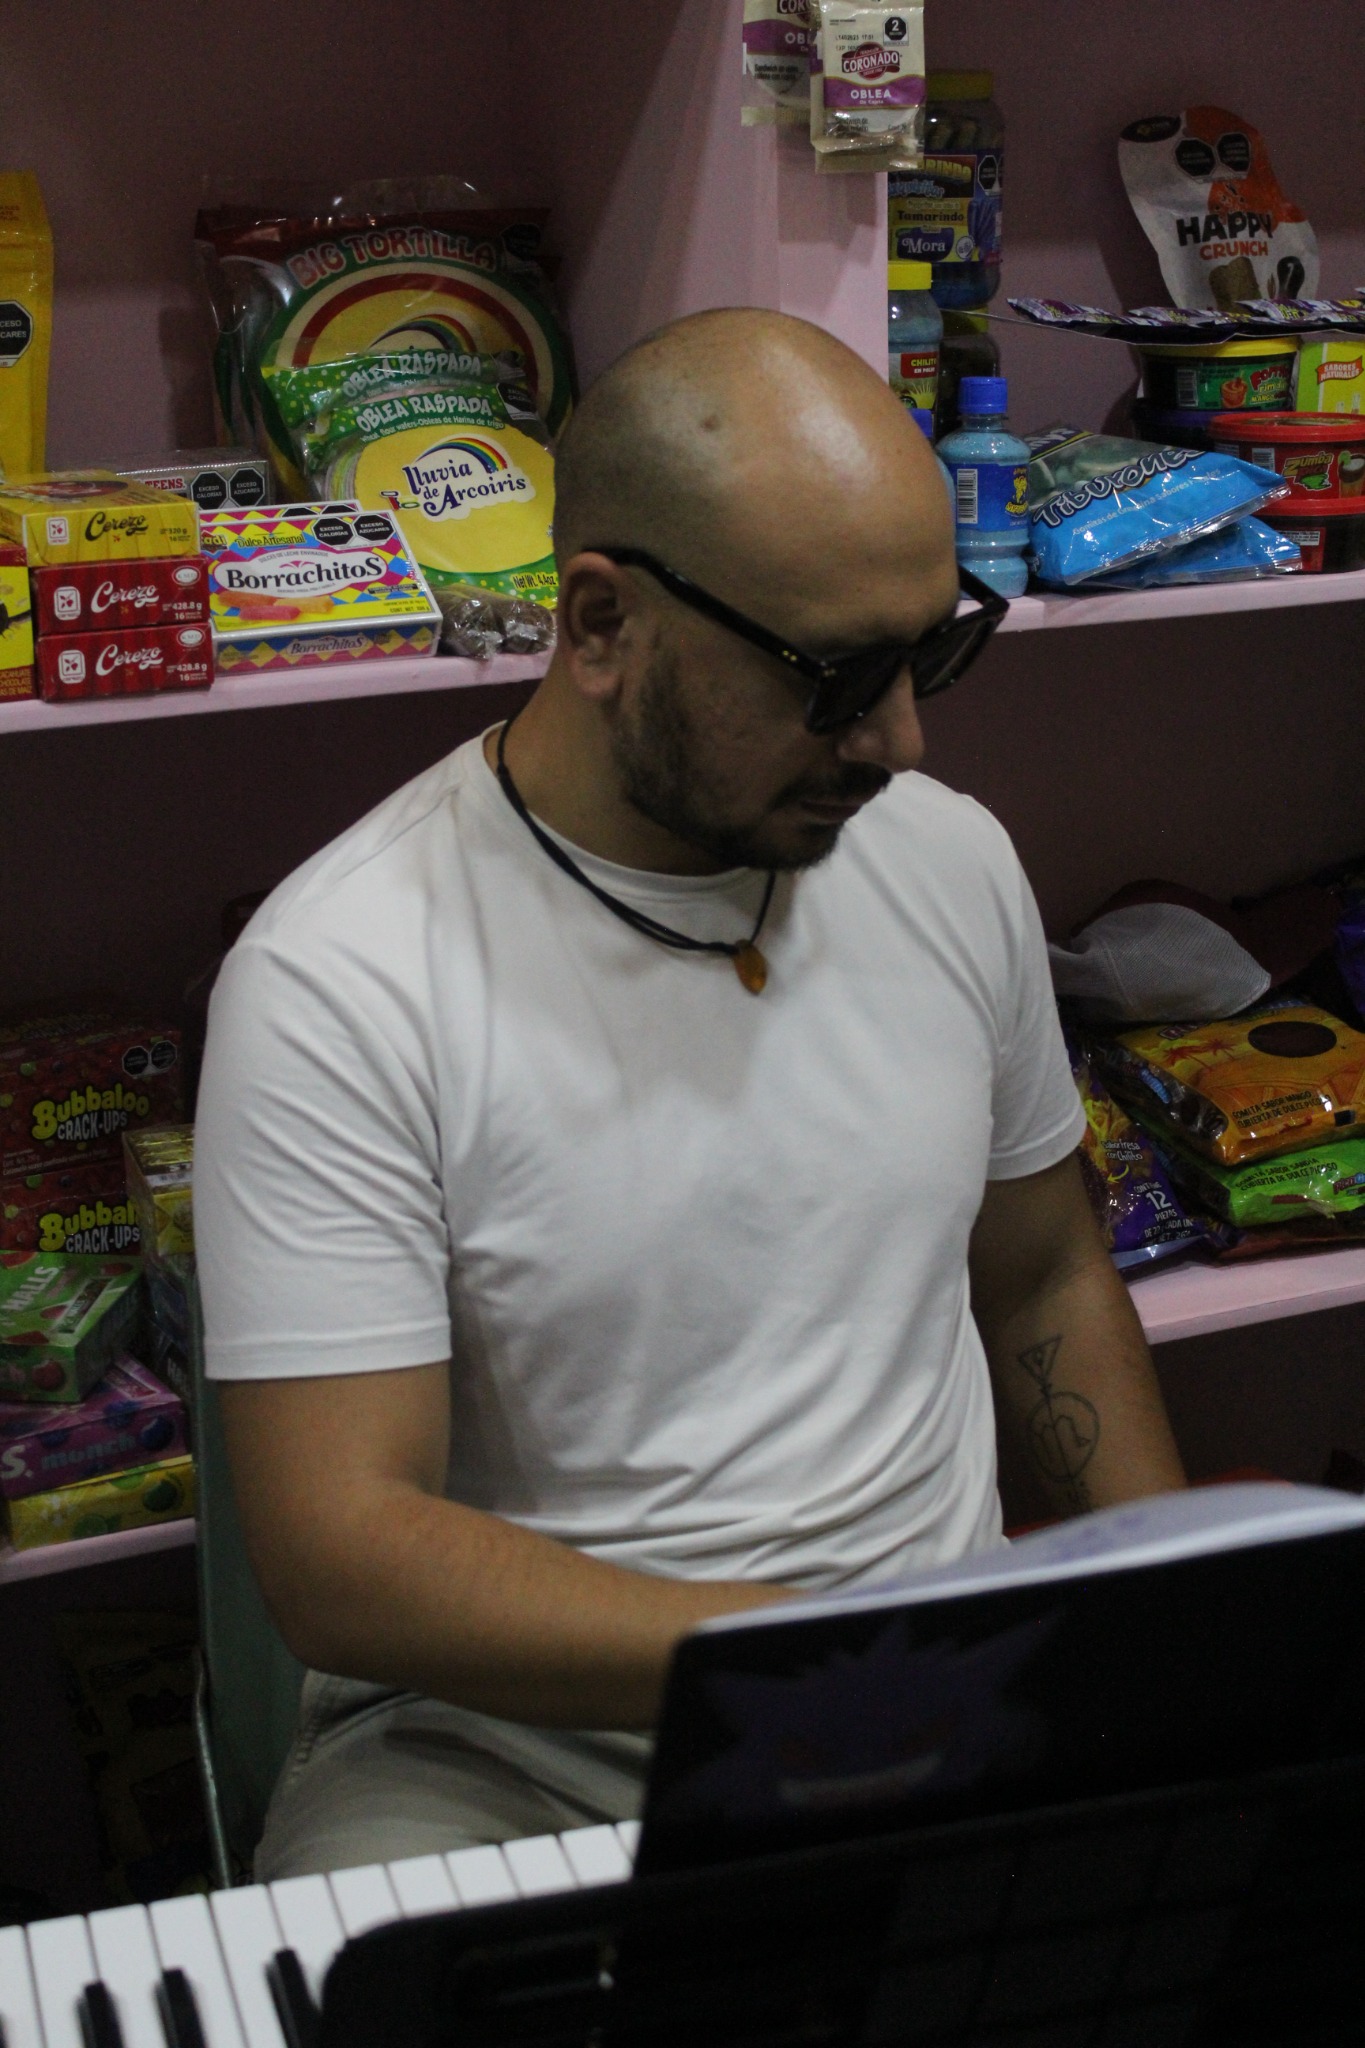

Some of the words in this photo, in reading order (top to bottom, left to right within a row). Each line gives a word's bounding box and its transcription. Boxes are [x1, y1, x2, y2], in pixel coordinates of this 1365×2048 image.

[891, 19, 899, 31] 2
[843, 51, 899, 73] CORONADO
[850, 88, 892, 99] OBLEA
[897, 210, 964, 221] Tamarindo
[1176, 211, 1273, 246] HAPPY
[901, 237, 946, 254] Mora
[1200, 240, 1269, 261] CRUNCH
[286, 242, 347, 290] BIG
[344, 226, 496, 272] TORTILLA
[342, 357, 395, 397] OBLEA
[398, 351, 481, 376] RASPADA
[1320, 369, 1360, 382] NATURALES
[1323, 363, 1356, 371] SABORES
[355, 399, 409, 433] OBLEA
[408, 393, 492, 416] RASPADA
[1283, 452, 1333, 477] Zumba
[198, 484, 220, 492] EXCESO
[423, 486, 439, 500] de
[423, 473, 527, 517] Arcoiris
[1106, 511, 1118, 522] de
[1156, 480, 1189, 502] Sabores
[85, 511, 149, 542] Cerezo
[235, 537, 263, 548] Dulce
[263, 534, 306, 546] Artesanal
[91, 581, 160, 614] Cerezo
[172, 602, 195, 611] 428.8
[196, 602, 203, 611] g
[175, 612, 185, 620] 16
[96, 644, 164, 677] Cerezo
[177, 663, 201, 672] 428.8
[201, 663, 208, 672] g
[180, 673, 190, 681] 16
[1261, 1096, 1285, 1109] SABOR
[1285, 1090, 1312, 1103] MANGO
[31, 1082, 150, 1140] Bubbaloo
[1237, 1111, 1272, 1128] CUBIERTA
[1273, 1106, 1283, 1116] DE
[1284, 1100, 1305, 1113] DULCE
[1304, 1094, 1332, 1108] PICOO
[57, 1110, 129, 1141] CRACK-UPS
[1240, 1177, 1277, 1191] CUBIERTA
[1277, 1173, 1287, 1182] DE
[1286, 1168, 1309, 1179] DULCE
[1266, 1164, 1289, 1176] SABOR
[1145, 1190, 1173, 1211] 12
[1154, 1208, 1178, 1222] PIEZAS
[65, 1225, 141, 1254] CRACK-UPS
[1144, 1227, 1153, 1238] DE
